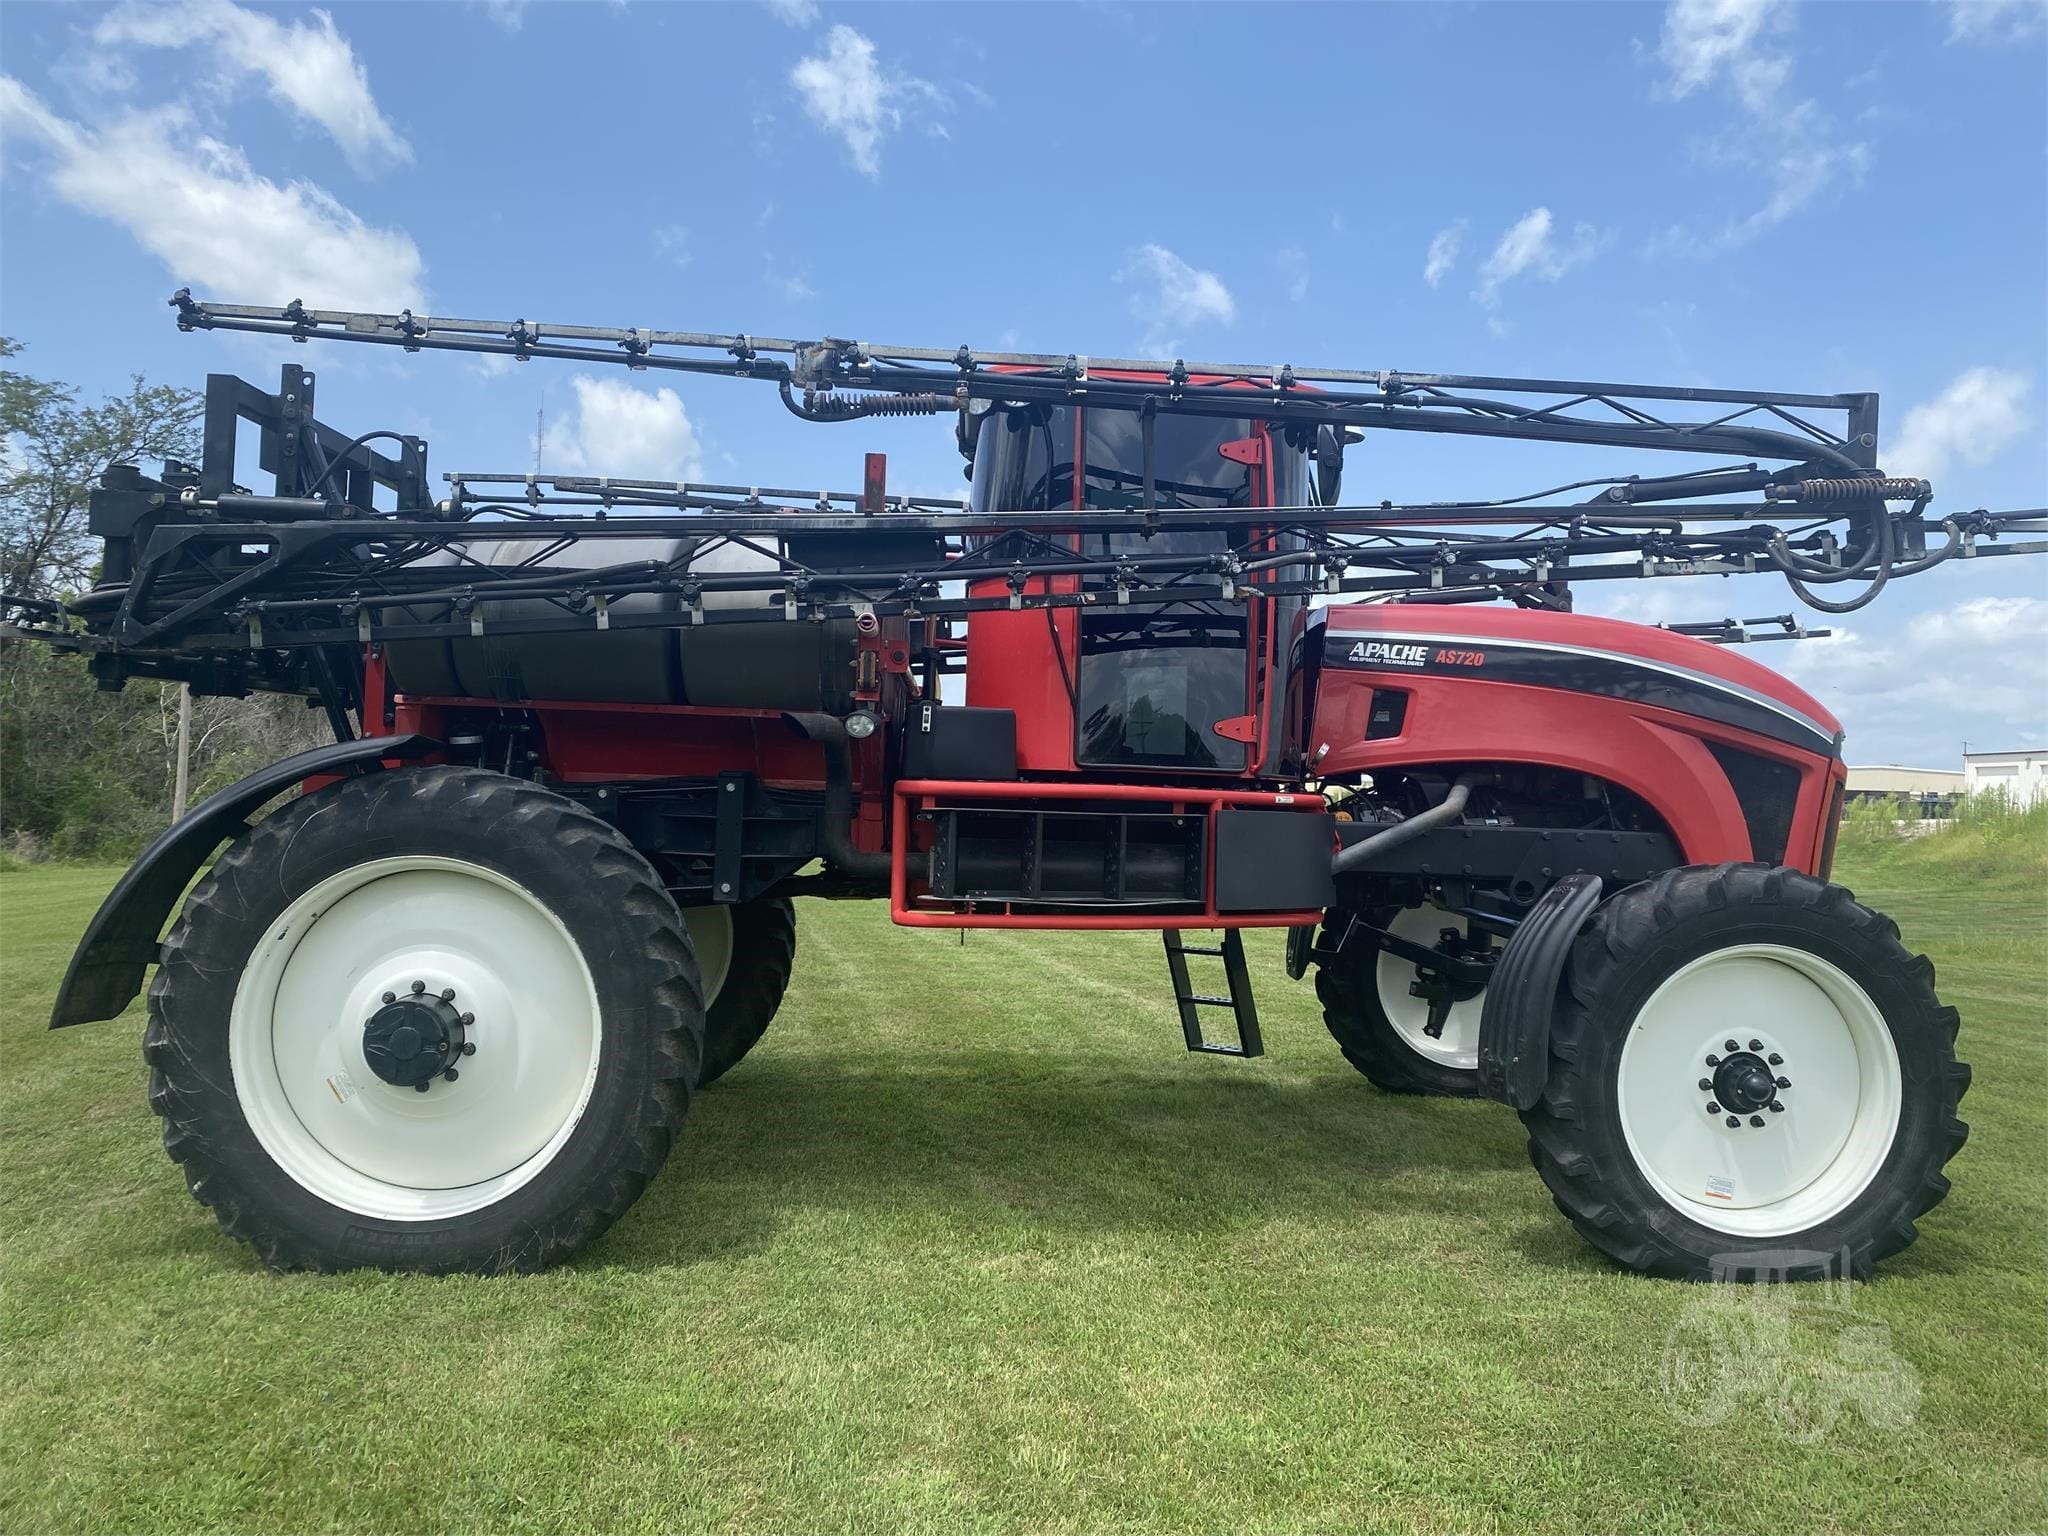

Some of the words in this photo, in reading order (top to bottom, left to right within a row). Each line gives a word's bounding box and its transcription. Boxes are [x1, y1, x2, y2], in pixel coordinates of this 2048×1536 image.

[1348, 656, 1382, 664] EQUIPMENT
[1382, 658, 1425, 667] TECHNOLOGIES
[1349, 641, 1429, 661] APACHE
[1435, 649, 1485, 666] AS720
